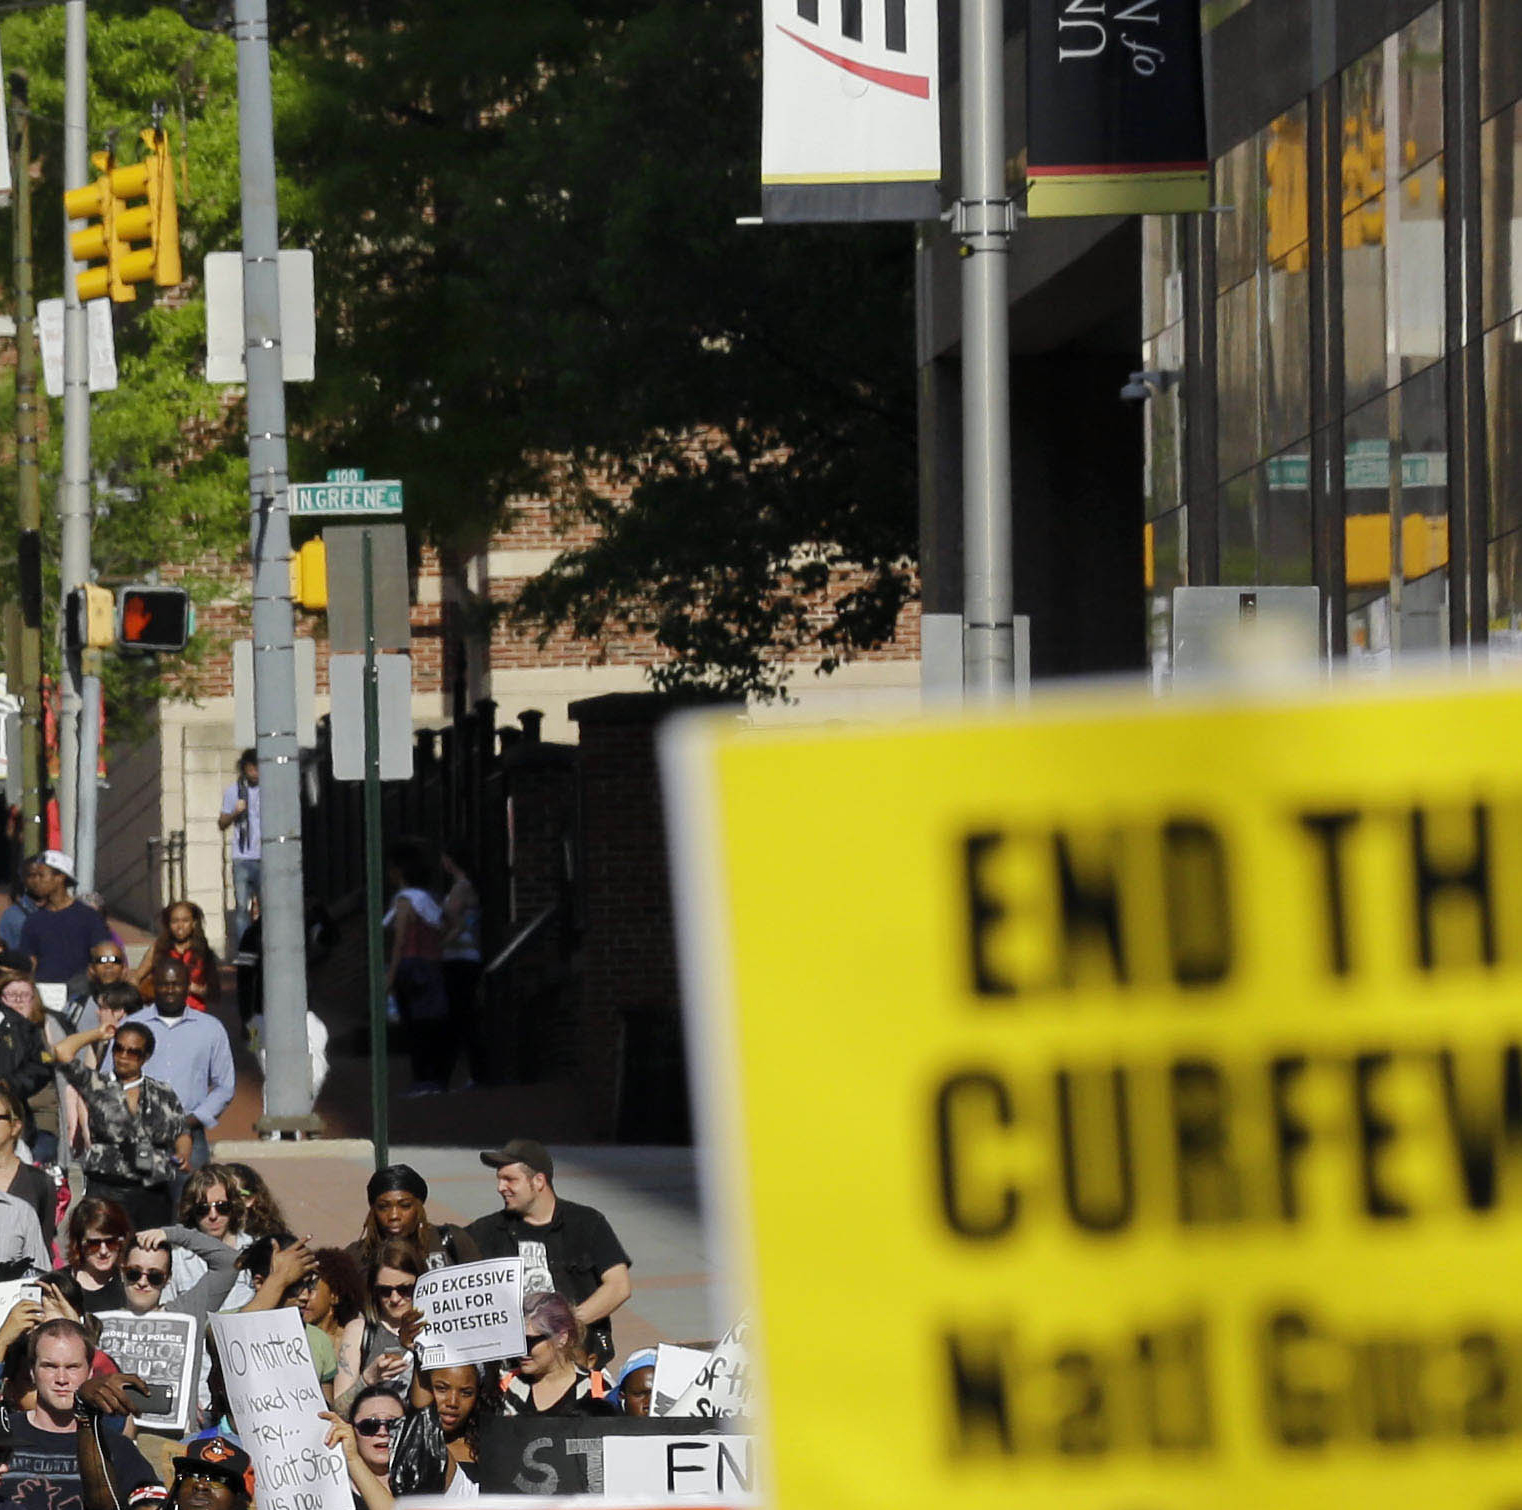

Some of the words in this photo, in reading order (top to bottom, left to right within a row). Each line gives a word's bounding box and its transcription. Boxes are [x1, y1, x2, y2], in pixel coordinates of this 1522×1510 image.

[334, 470, 358, 482] 100
[315, 487, 387, 508] GREENE
[960, 812, 1235, 1000] END
[935, 1040, 1522, 1244] CURFEW
[416, 1282, 439, 1300] END
[442, 1269, 516, 1293] EXCESSIVE
[432, 1296, 463, 1316] BAIL
[465, 1293, 494, 1311] FOR
[423, 1310, 509, 1337] PROTESTERS
[147, 1333, 183, 1343] POLICE
[33, 1460, 71, 1473] CLOWN
